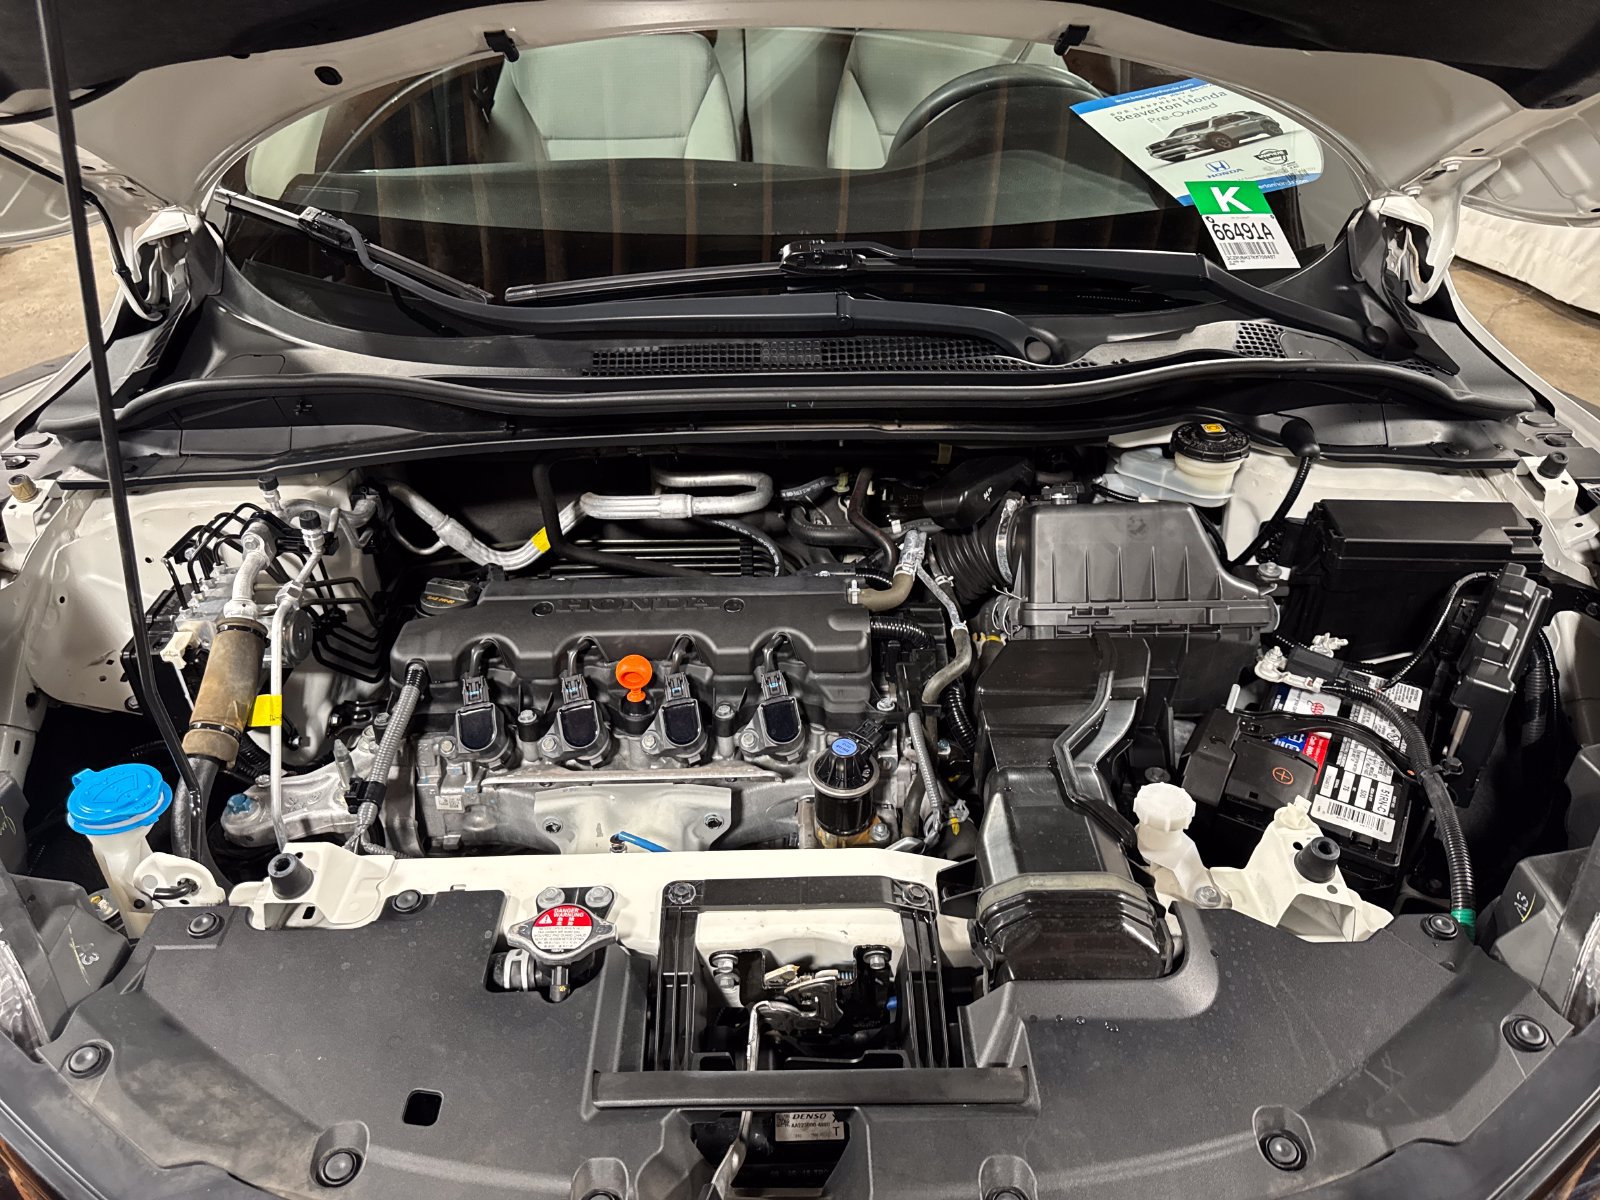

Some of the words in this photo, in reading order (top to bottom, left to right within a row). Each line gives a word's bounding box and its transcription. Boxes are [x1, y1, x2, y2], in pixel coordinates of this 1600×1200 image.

[1113, 101, 1181, 123] Beaverton
[1183, 90, 1228, 106] Honda
[1147, 102, 1219, 124] Pre-Owned
[1206, 168, 1244, 179] HONDA
[1209, 186, 1254, 212] K
[1211, 222, 1275, 241] 66491A
[556, 598, 721, 613] HONDA
[1375, 789, 1391, 813] 51RN-C
[792, 1112, 827, 1120] DENSO
[832, 1126, 840, 1136] T
